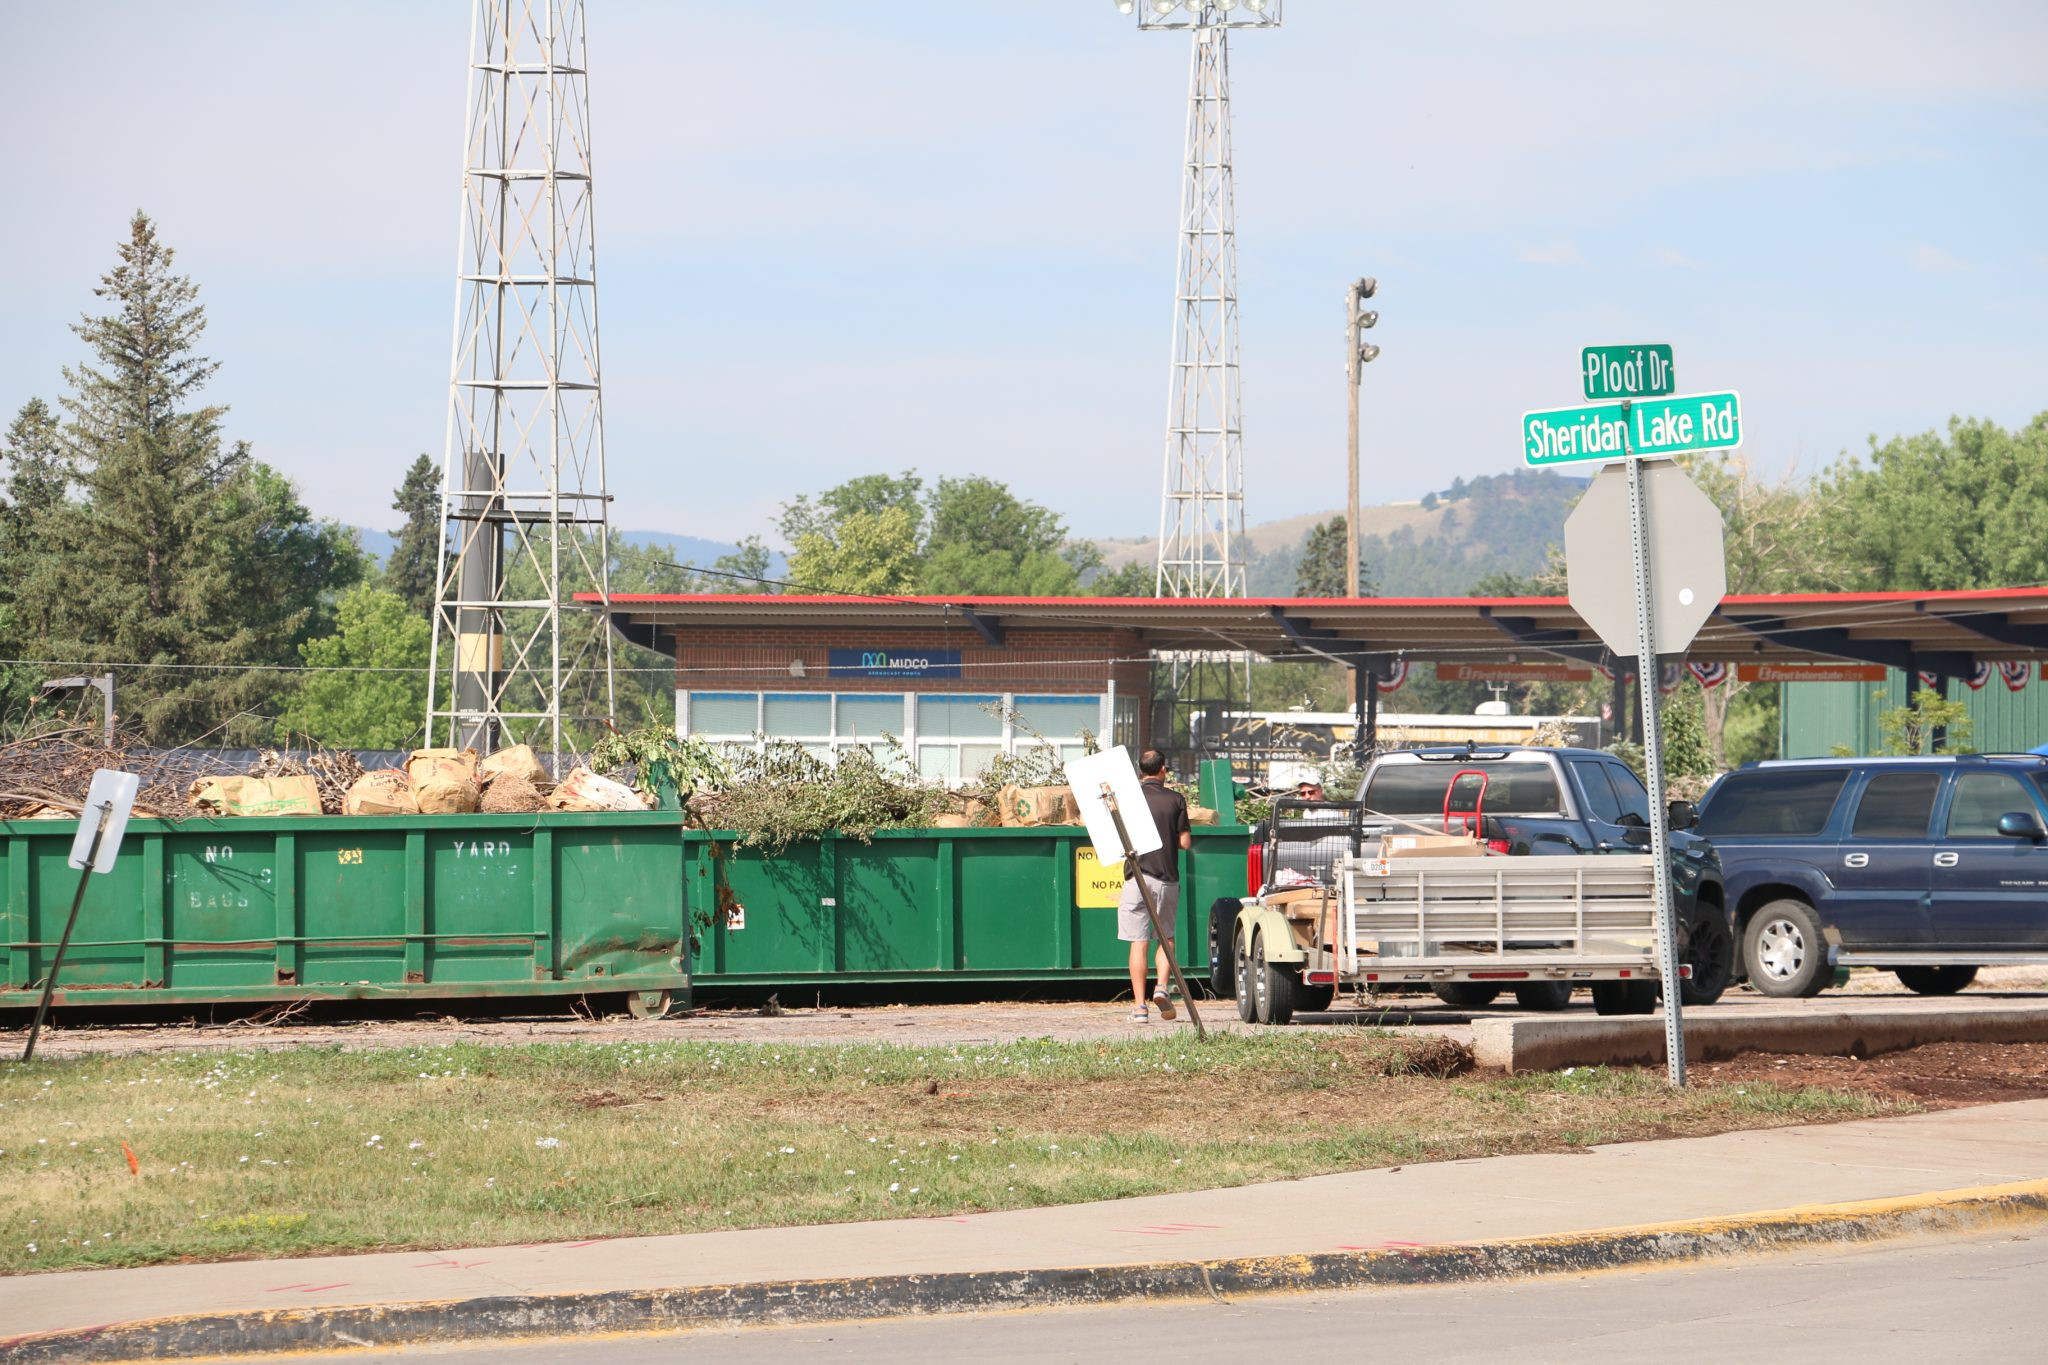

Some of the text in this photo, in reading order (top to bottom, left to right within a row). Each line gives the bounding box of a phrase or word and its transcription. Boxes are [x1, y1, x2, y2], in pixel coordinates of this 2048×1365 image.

[1587, 350, 1669, 393] Ploof Dr
[1529, 400, 1734, 458] Sheridan Lake Rd
[889, 658, 928, 669] MIDCO
[1264, 752, 1310, 760] HOSPITA
[205, 846, 232, 863] NO
[453, 841, 510, 859] YARD
[1078, 852, 1093, 860] NO
[1091, 881, 1124, 889] NO PA
